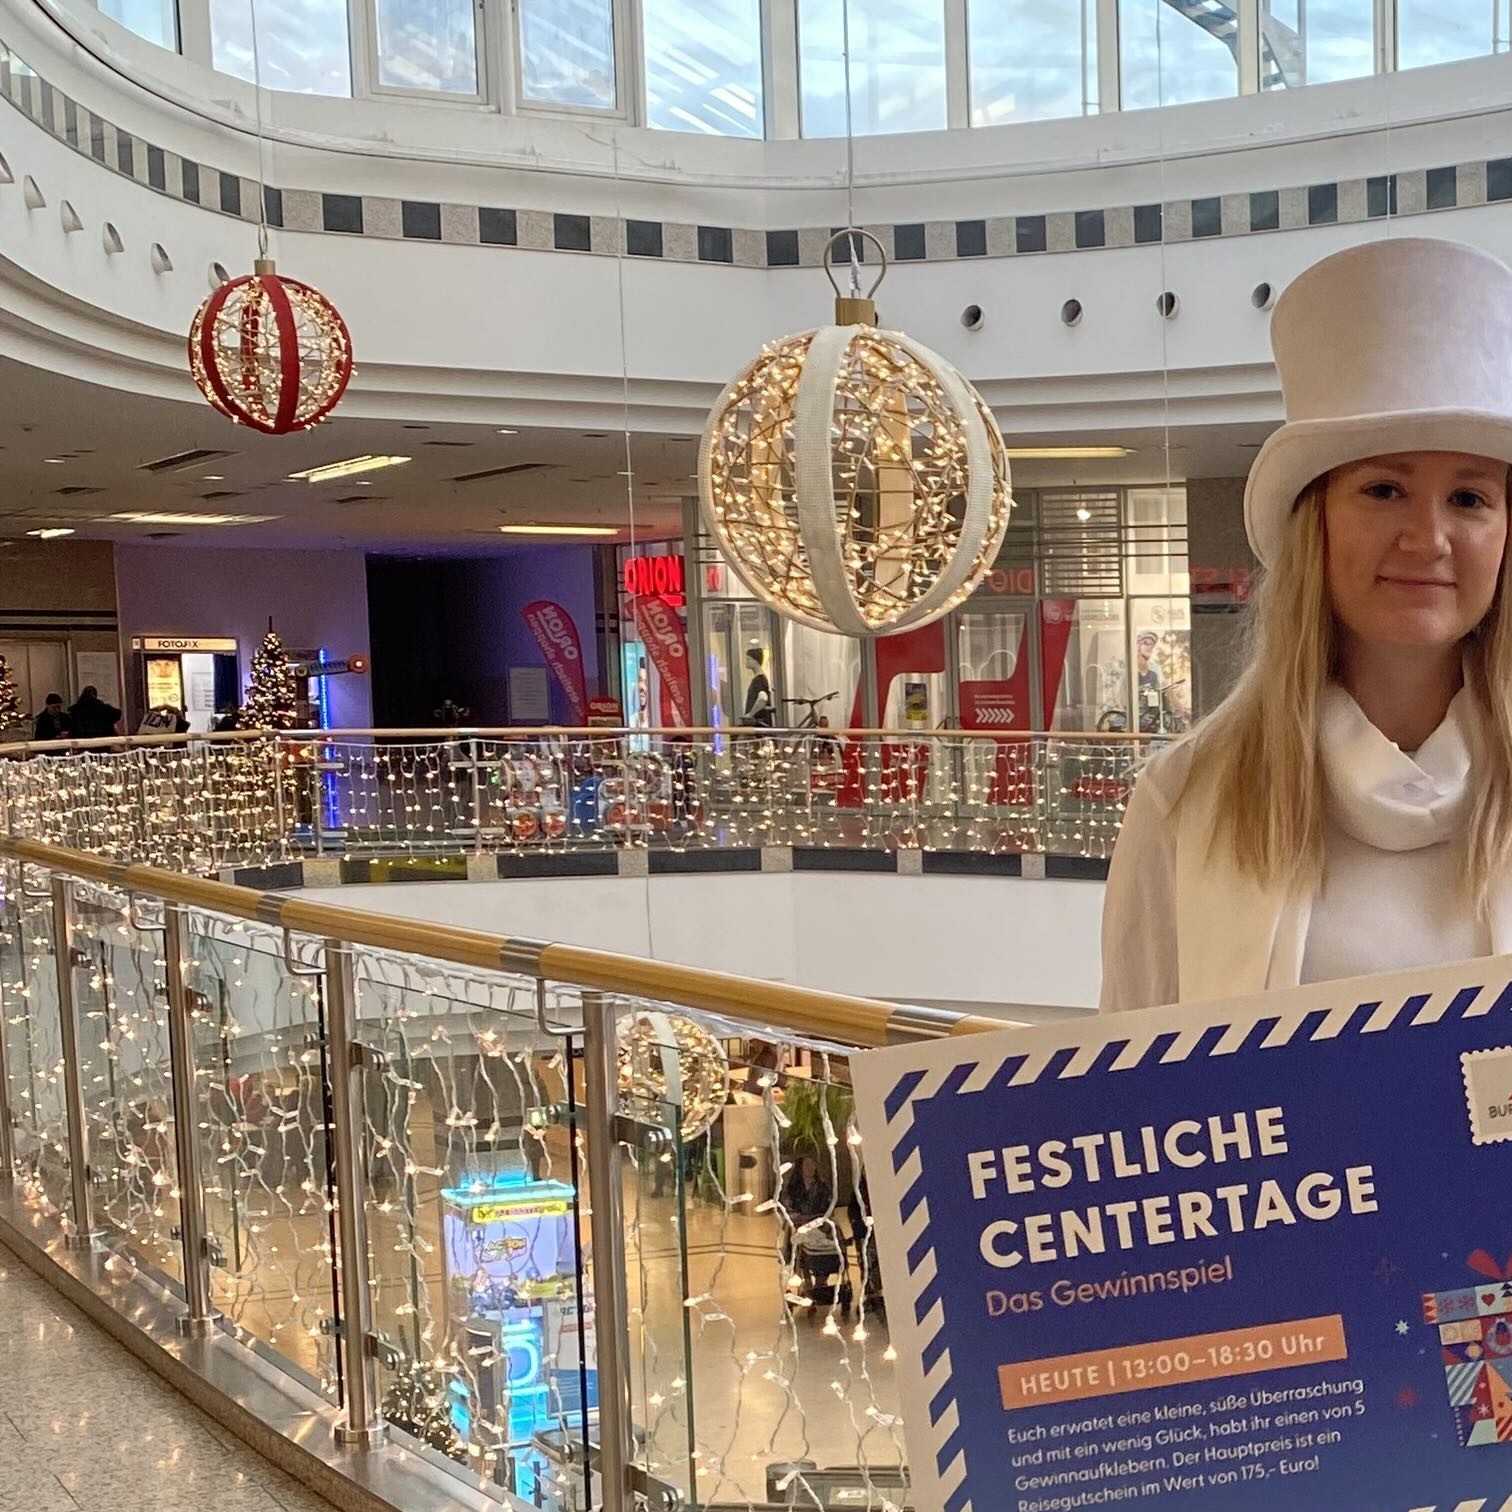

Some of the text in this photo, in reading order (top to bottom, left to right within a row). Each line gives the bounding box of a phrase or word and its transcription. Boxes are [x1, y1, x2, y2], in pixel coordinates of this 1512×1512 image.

[624, 555, 682, 594] ORION
[967, 1106, 1288, 1199] FESTLICHE
[979, 1165, 1379, 1268] CENTERTAGE
[986, 1255, 1234, 1317] Das Gewinnspiel
[1021, 1365, 1100, 1396] HEUTE
[1281, 1334, 1325, 1356] Uhr
[1008, 1378, 1364, 1444] Euch erwatet eine kleine, süße Überraschung
[1012, 1399, 1366, 1468] und mit ein wenig Glück, habt ihr einen von 5
[1015, 1430, 1341, 1492] Gewinnaufklebern. Der Hauptpreis ist ein
[1142, 1481, 1161, 1497] im
[1163, 1473, 1205, 1492] Wert
[1208, 1469, 1238, 1485] von
[1279, 1455, 1320, 1475] Euro!
